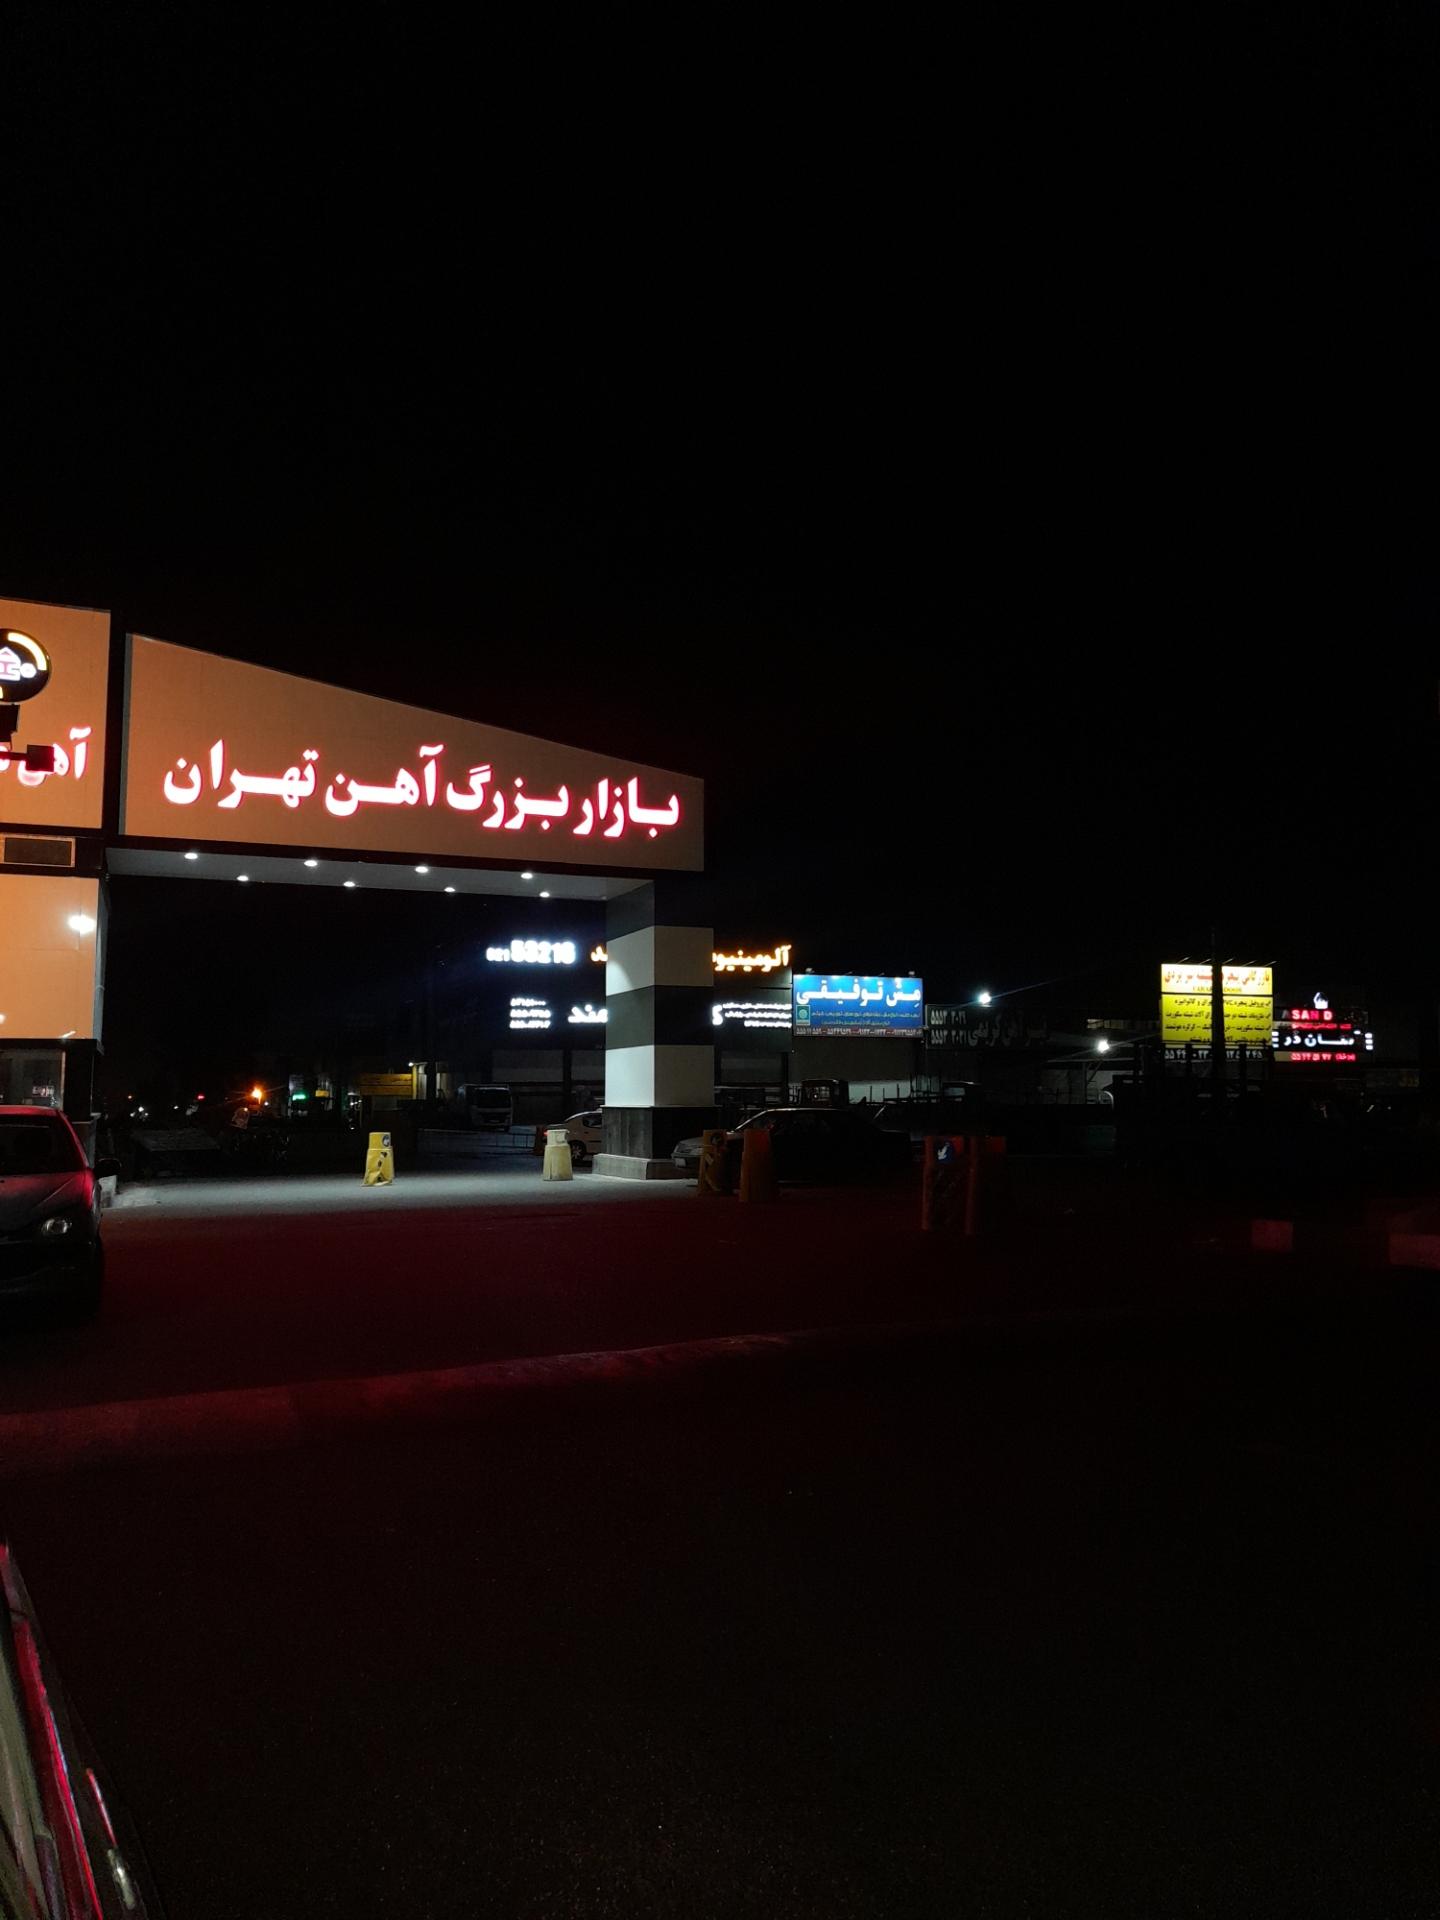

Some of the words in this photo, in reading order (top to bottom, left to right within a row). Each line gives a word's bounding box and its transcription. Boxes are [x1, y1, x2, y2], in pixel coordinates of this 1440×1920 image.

[162, 738, 321, 810] تهران
[324, 744, 446, 817] آهن
[446, 763, 570, 829] بزرگ
[572, 776, 680, 838] بازار
